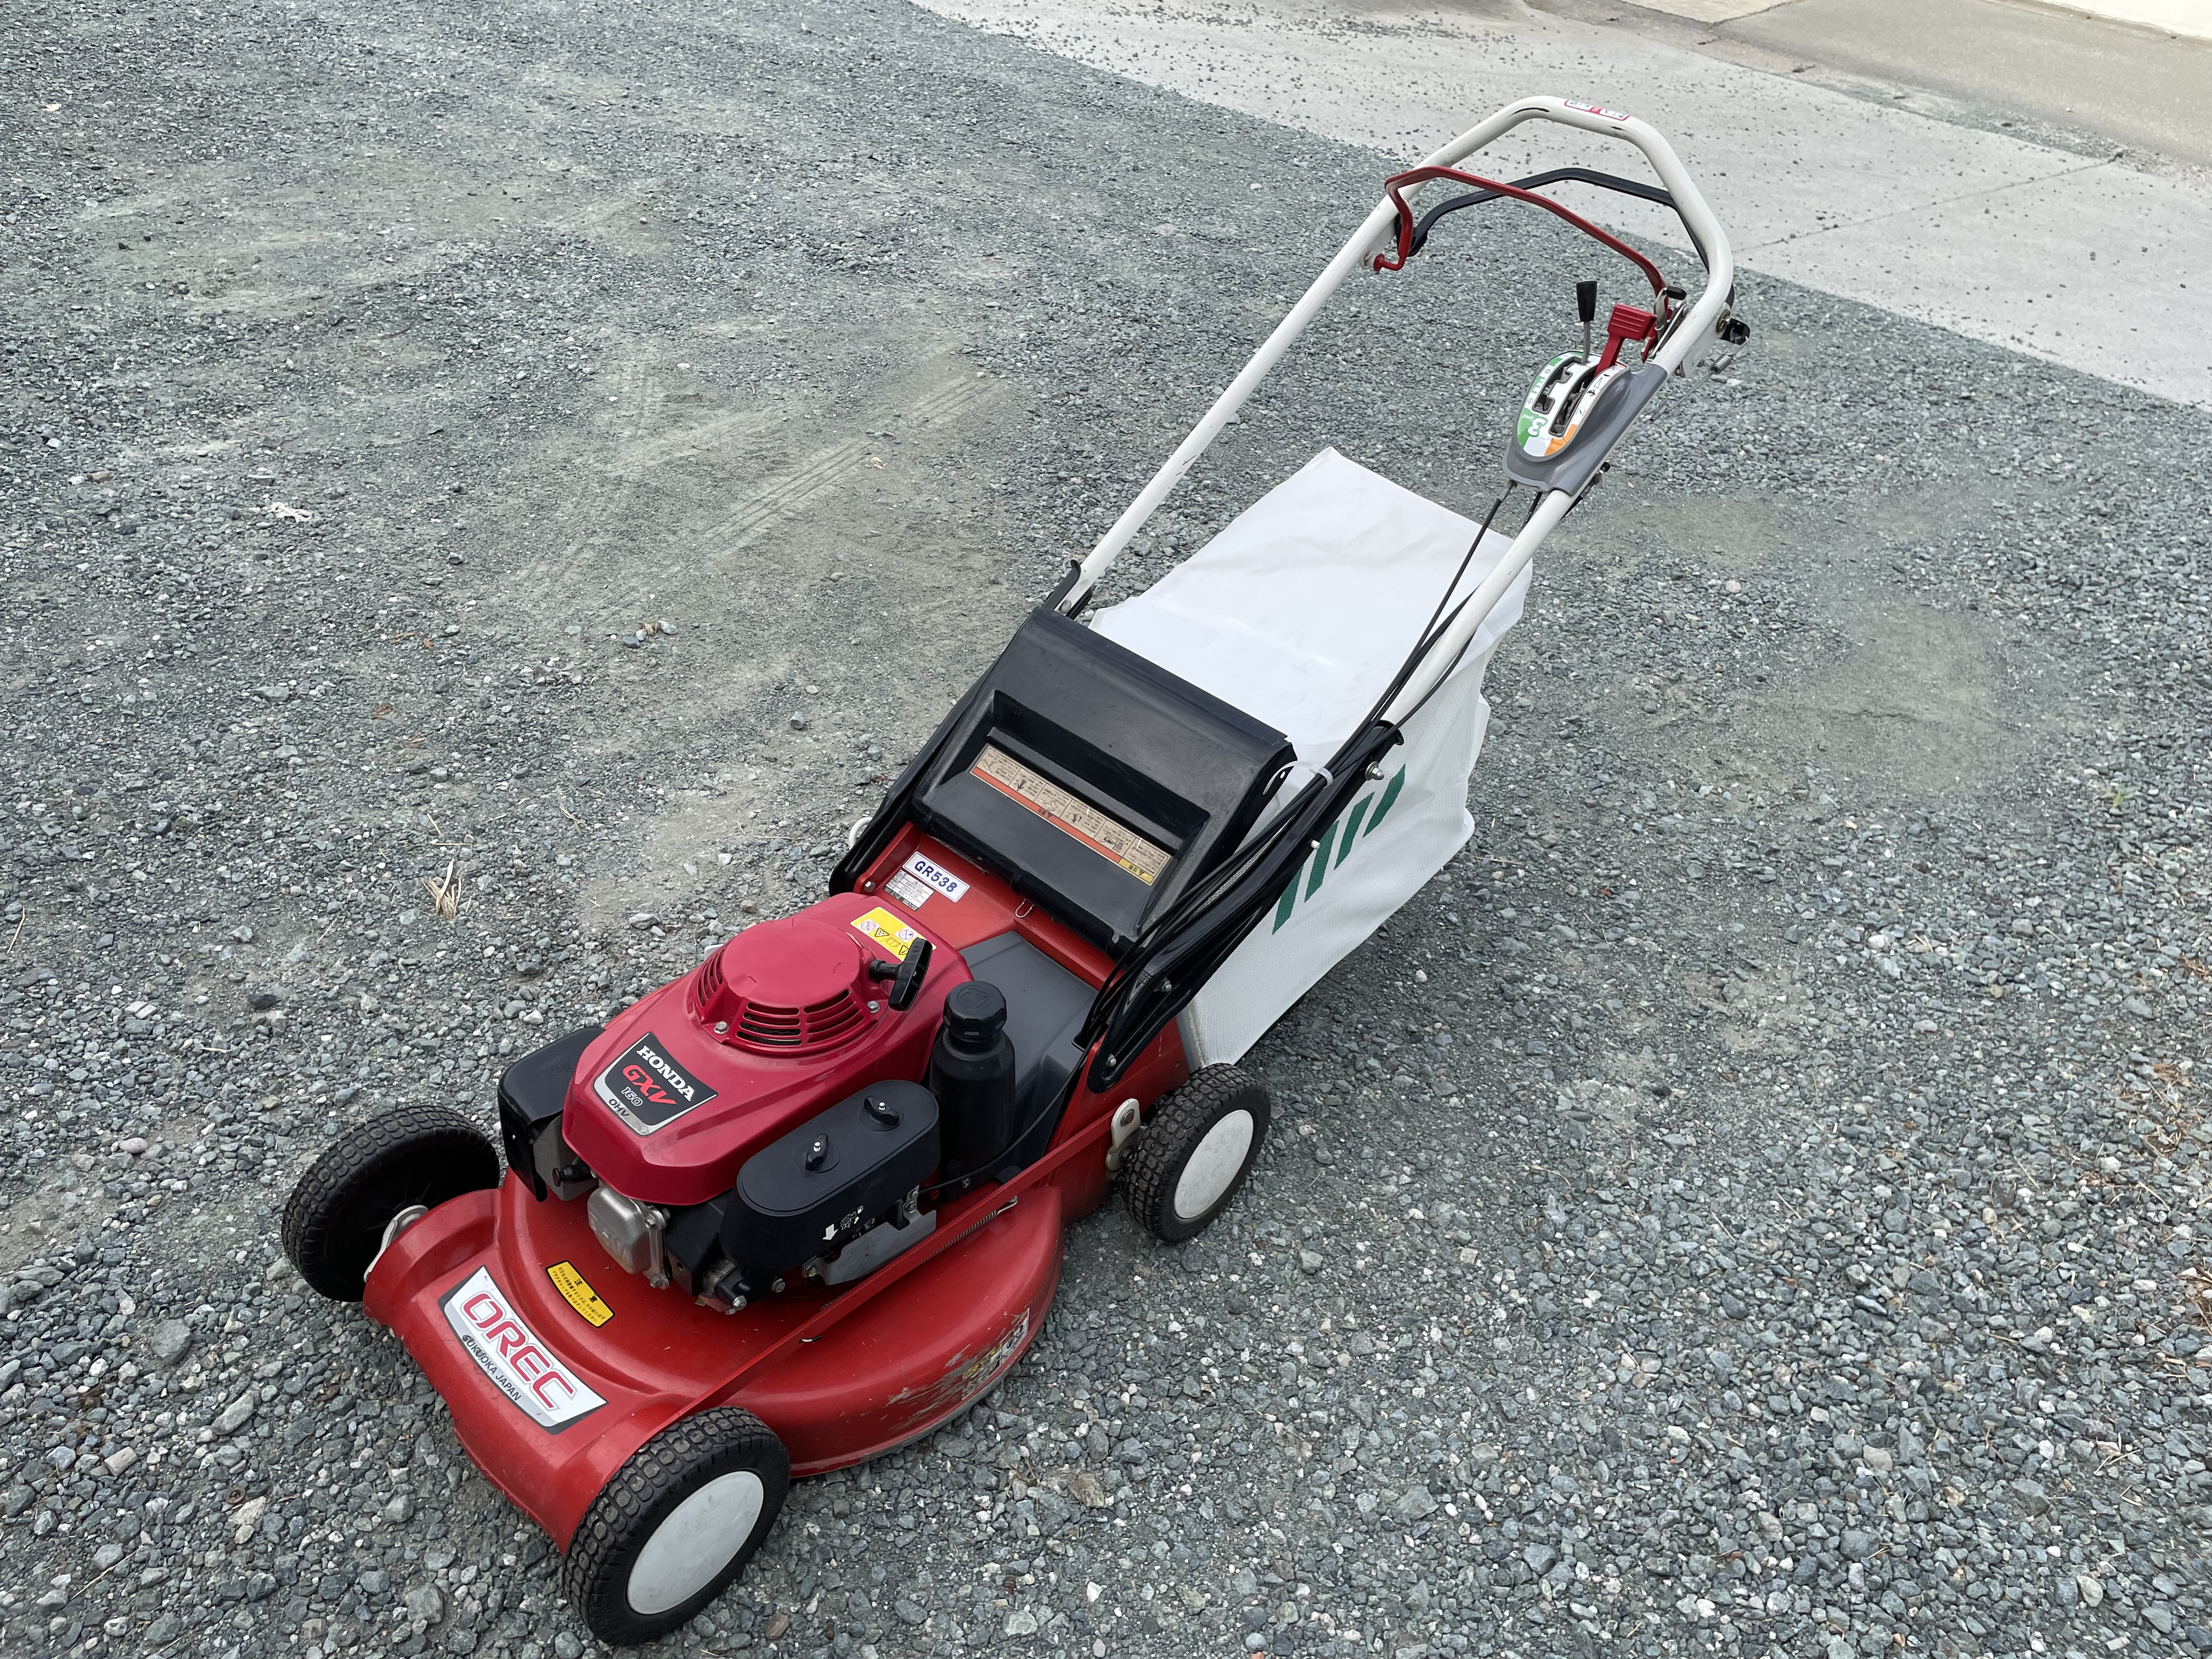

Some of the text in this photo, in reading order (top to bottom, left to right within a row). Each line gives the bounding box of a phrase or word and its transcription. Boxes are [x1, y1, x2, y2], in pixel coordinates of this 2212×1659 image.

[1527, 416, 1548, 437] 3
[914, 861, 957, 893] GR538
[622, 1064, 677, 1104] GXV
[636, 1045, 695, 1102] HONDA
[608, 1098, 630, 1117] OHV
[620, 1086, 643, 1107] 160
[461, 1291, 575, 1410] OREC
[495, 1375, 522, 1401] JAPAN
